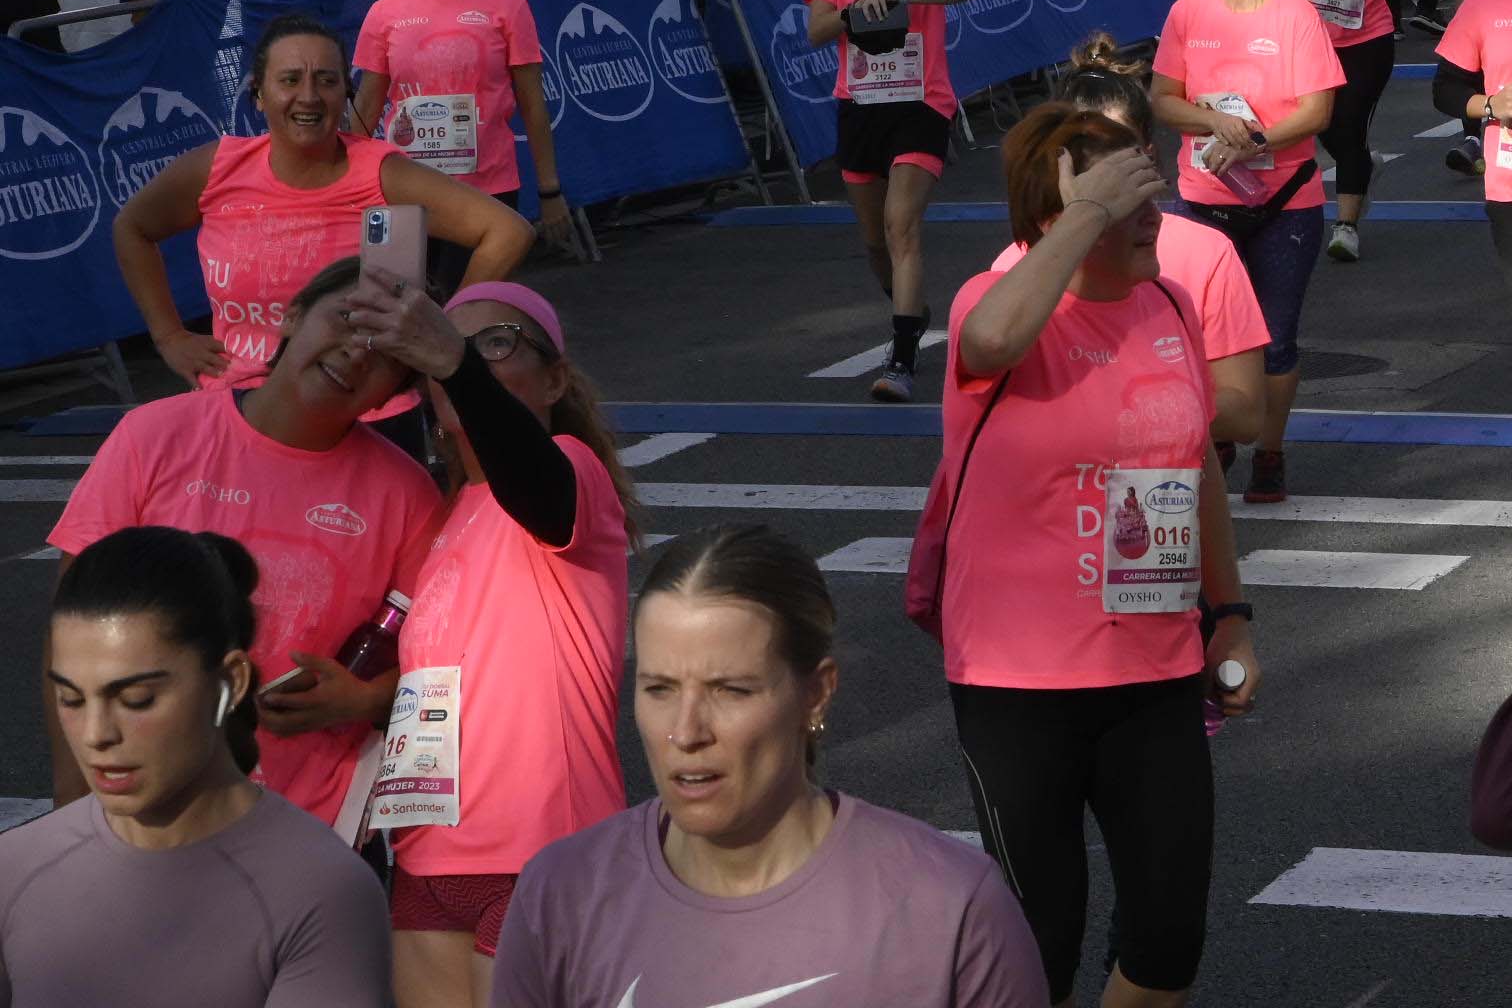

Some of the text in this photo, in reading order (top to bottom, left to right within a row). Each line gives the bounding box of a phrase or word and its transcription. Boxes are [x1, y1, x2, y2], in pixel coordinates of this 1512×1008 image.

[1188, 39, 1221, 49] OYSHO
[870, 61, 897, 72] 016
[565, 51, 650, 97] ASTURIANA
[416, 126, 447, 139] 016
[423, 141, 441, 150] 1585
[186, 479, 251, 505] OYSHO
[1149, 493, 1194, 506] ASTURIANA
[310, 511, 363, 533] ASTURIANA
[1154, 526, 1191, 546] 016
[1159, 552, 1187, 565] 25948
[1123, 573, 1161, 581] CARRERA
[1172, 572, 1182, 580] LA
[1118, 591, 1162, 603] OYSHO
[422, 689, 449, 698] SUMA
[386, 734, 407, 757] 16
[385, 781, 415, 791] MUJER
[418, 781, 441, 791] 2023
[392, 802, 446, 815] Santander
